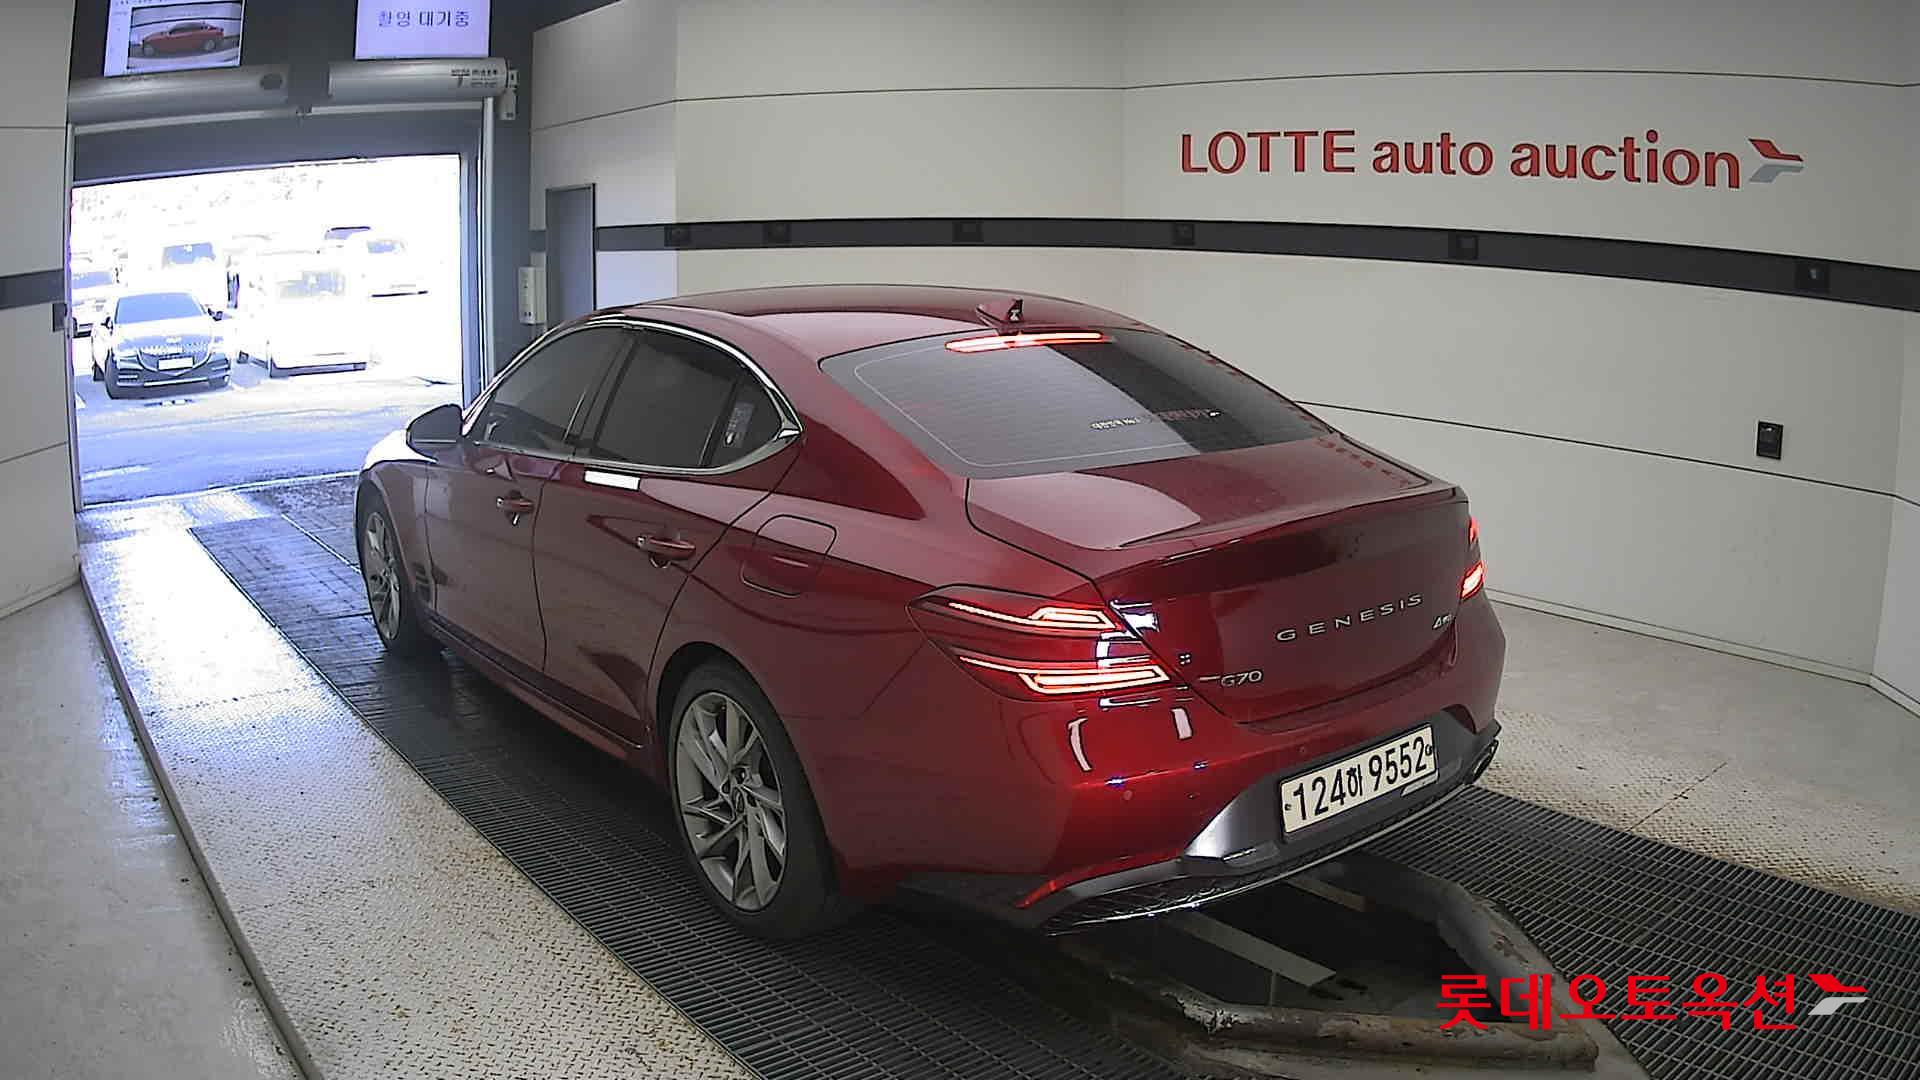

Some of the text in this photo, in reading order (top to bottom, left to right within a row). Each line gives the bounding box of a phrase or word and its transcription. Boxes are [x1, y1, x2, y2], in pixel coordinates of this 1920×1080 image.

[418, 10, 470, 28] 대기중
[1181, 129, 1741, 188] LOTTE auto auction
[1275, 593, 1424, 642] GENESIS
[1220, 670, 1264, 688] G70
[1292, 736, 1427, 821] 124하 9552
